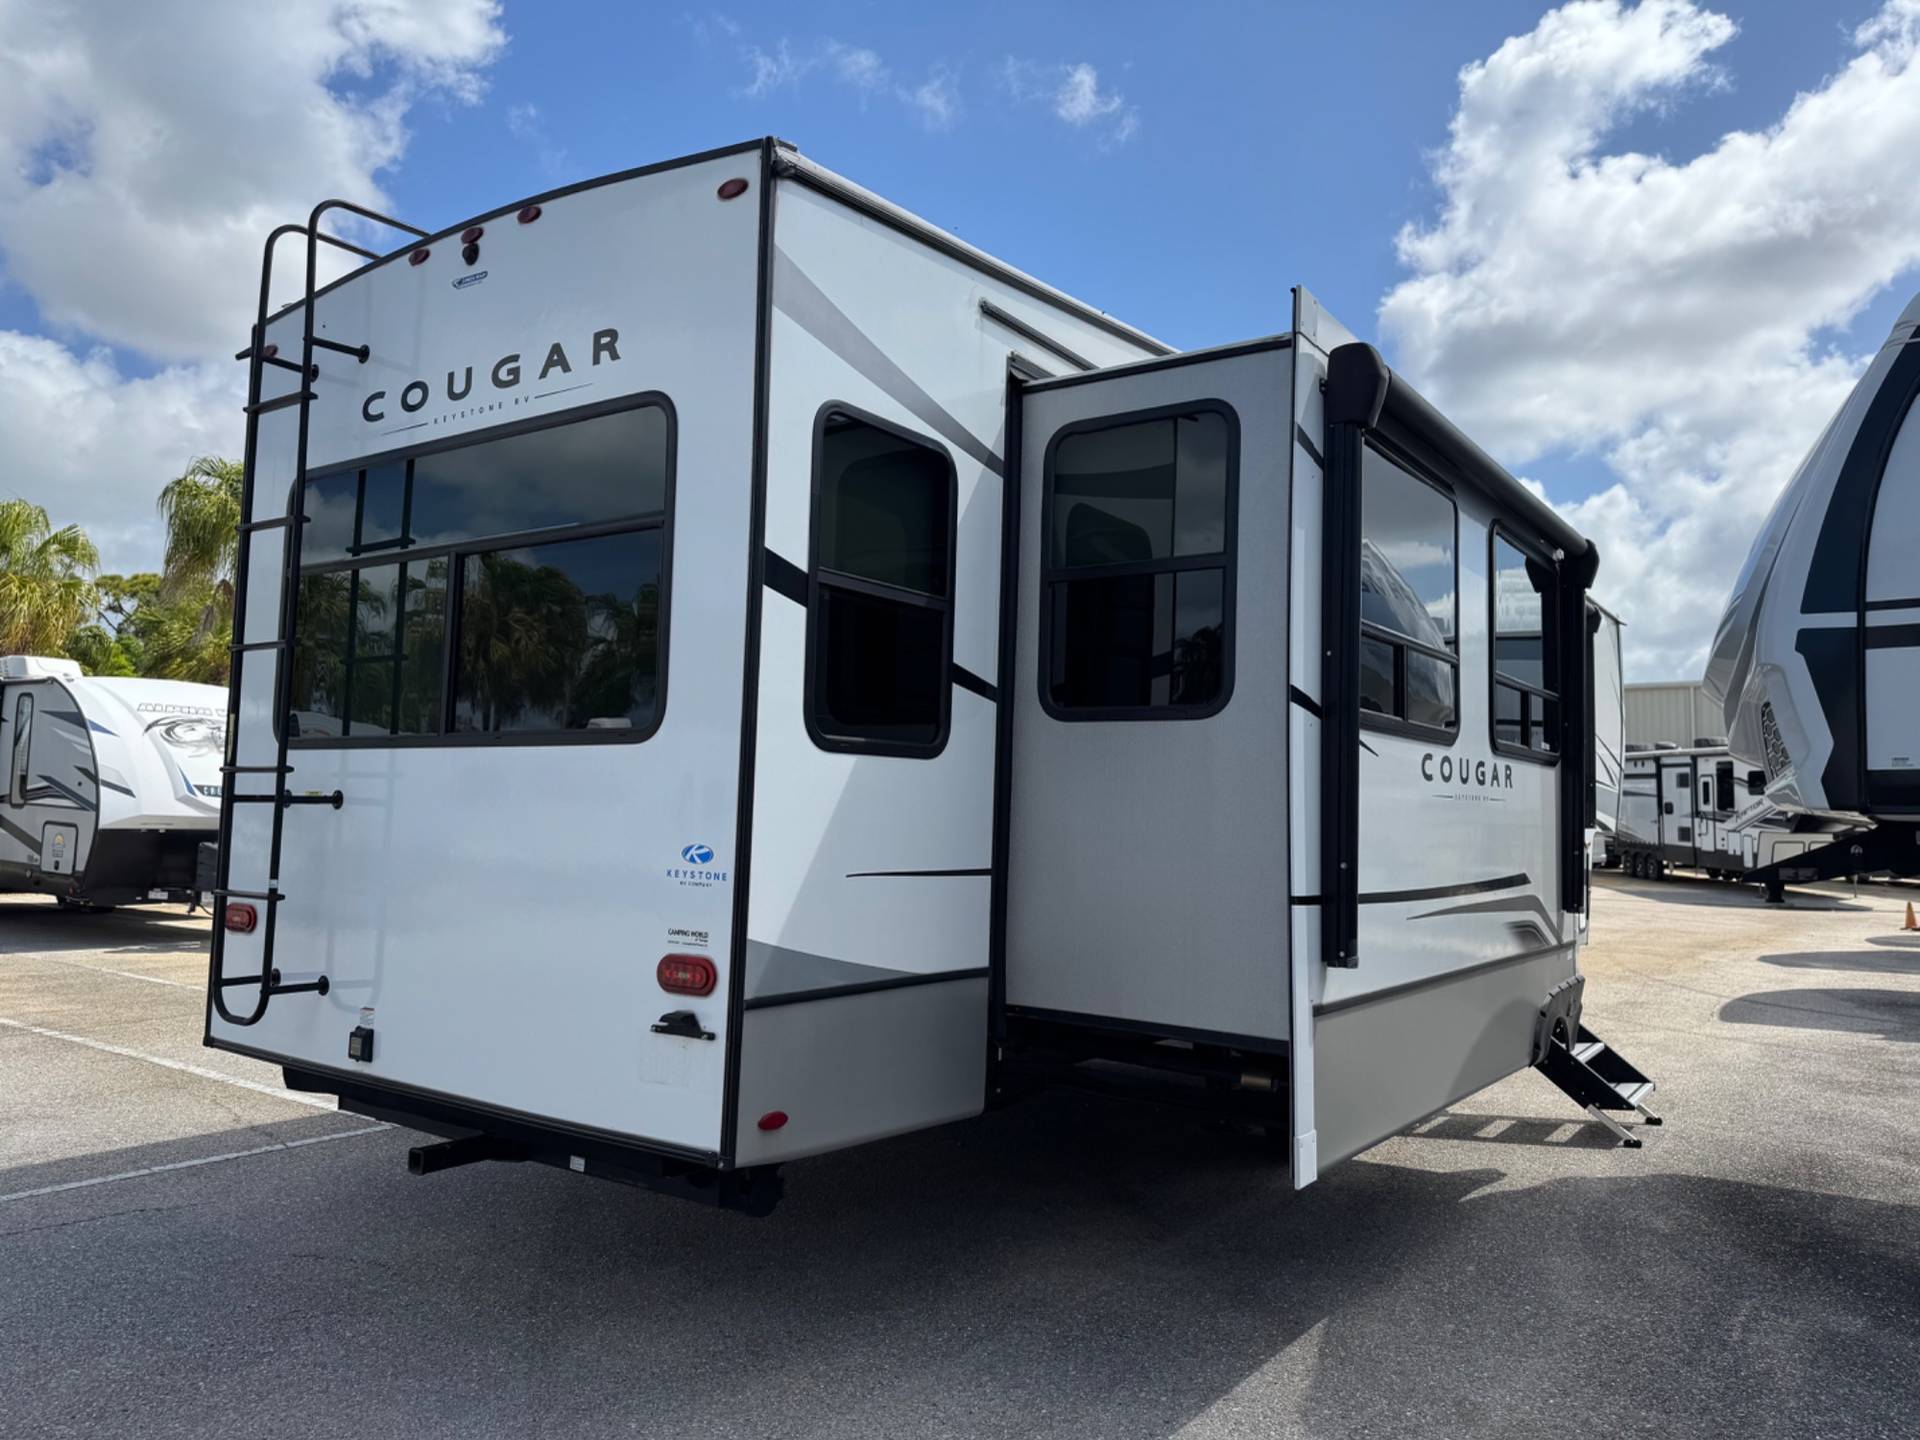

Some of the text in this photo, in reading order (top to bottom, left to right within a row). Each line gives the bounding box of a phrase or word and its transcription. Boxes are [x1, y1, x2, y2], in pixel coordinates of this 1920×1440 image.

[362, 328, 621, 422] COUGAR
[433, 395, 529, 424] KEYSTONE RV
[1421, 753, 1513, 788] COUGAR
[666, 869, 727, 881] KEYSTONE
